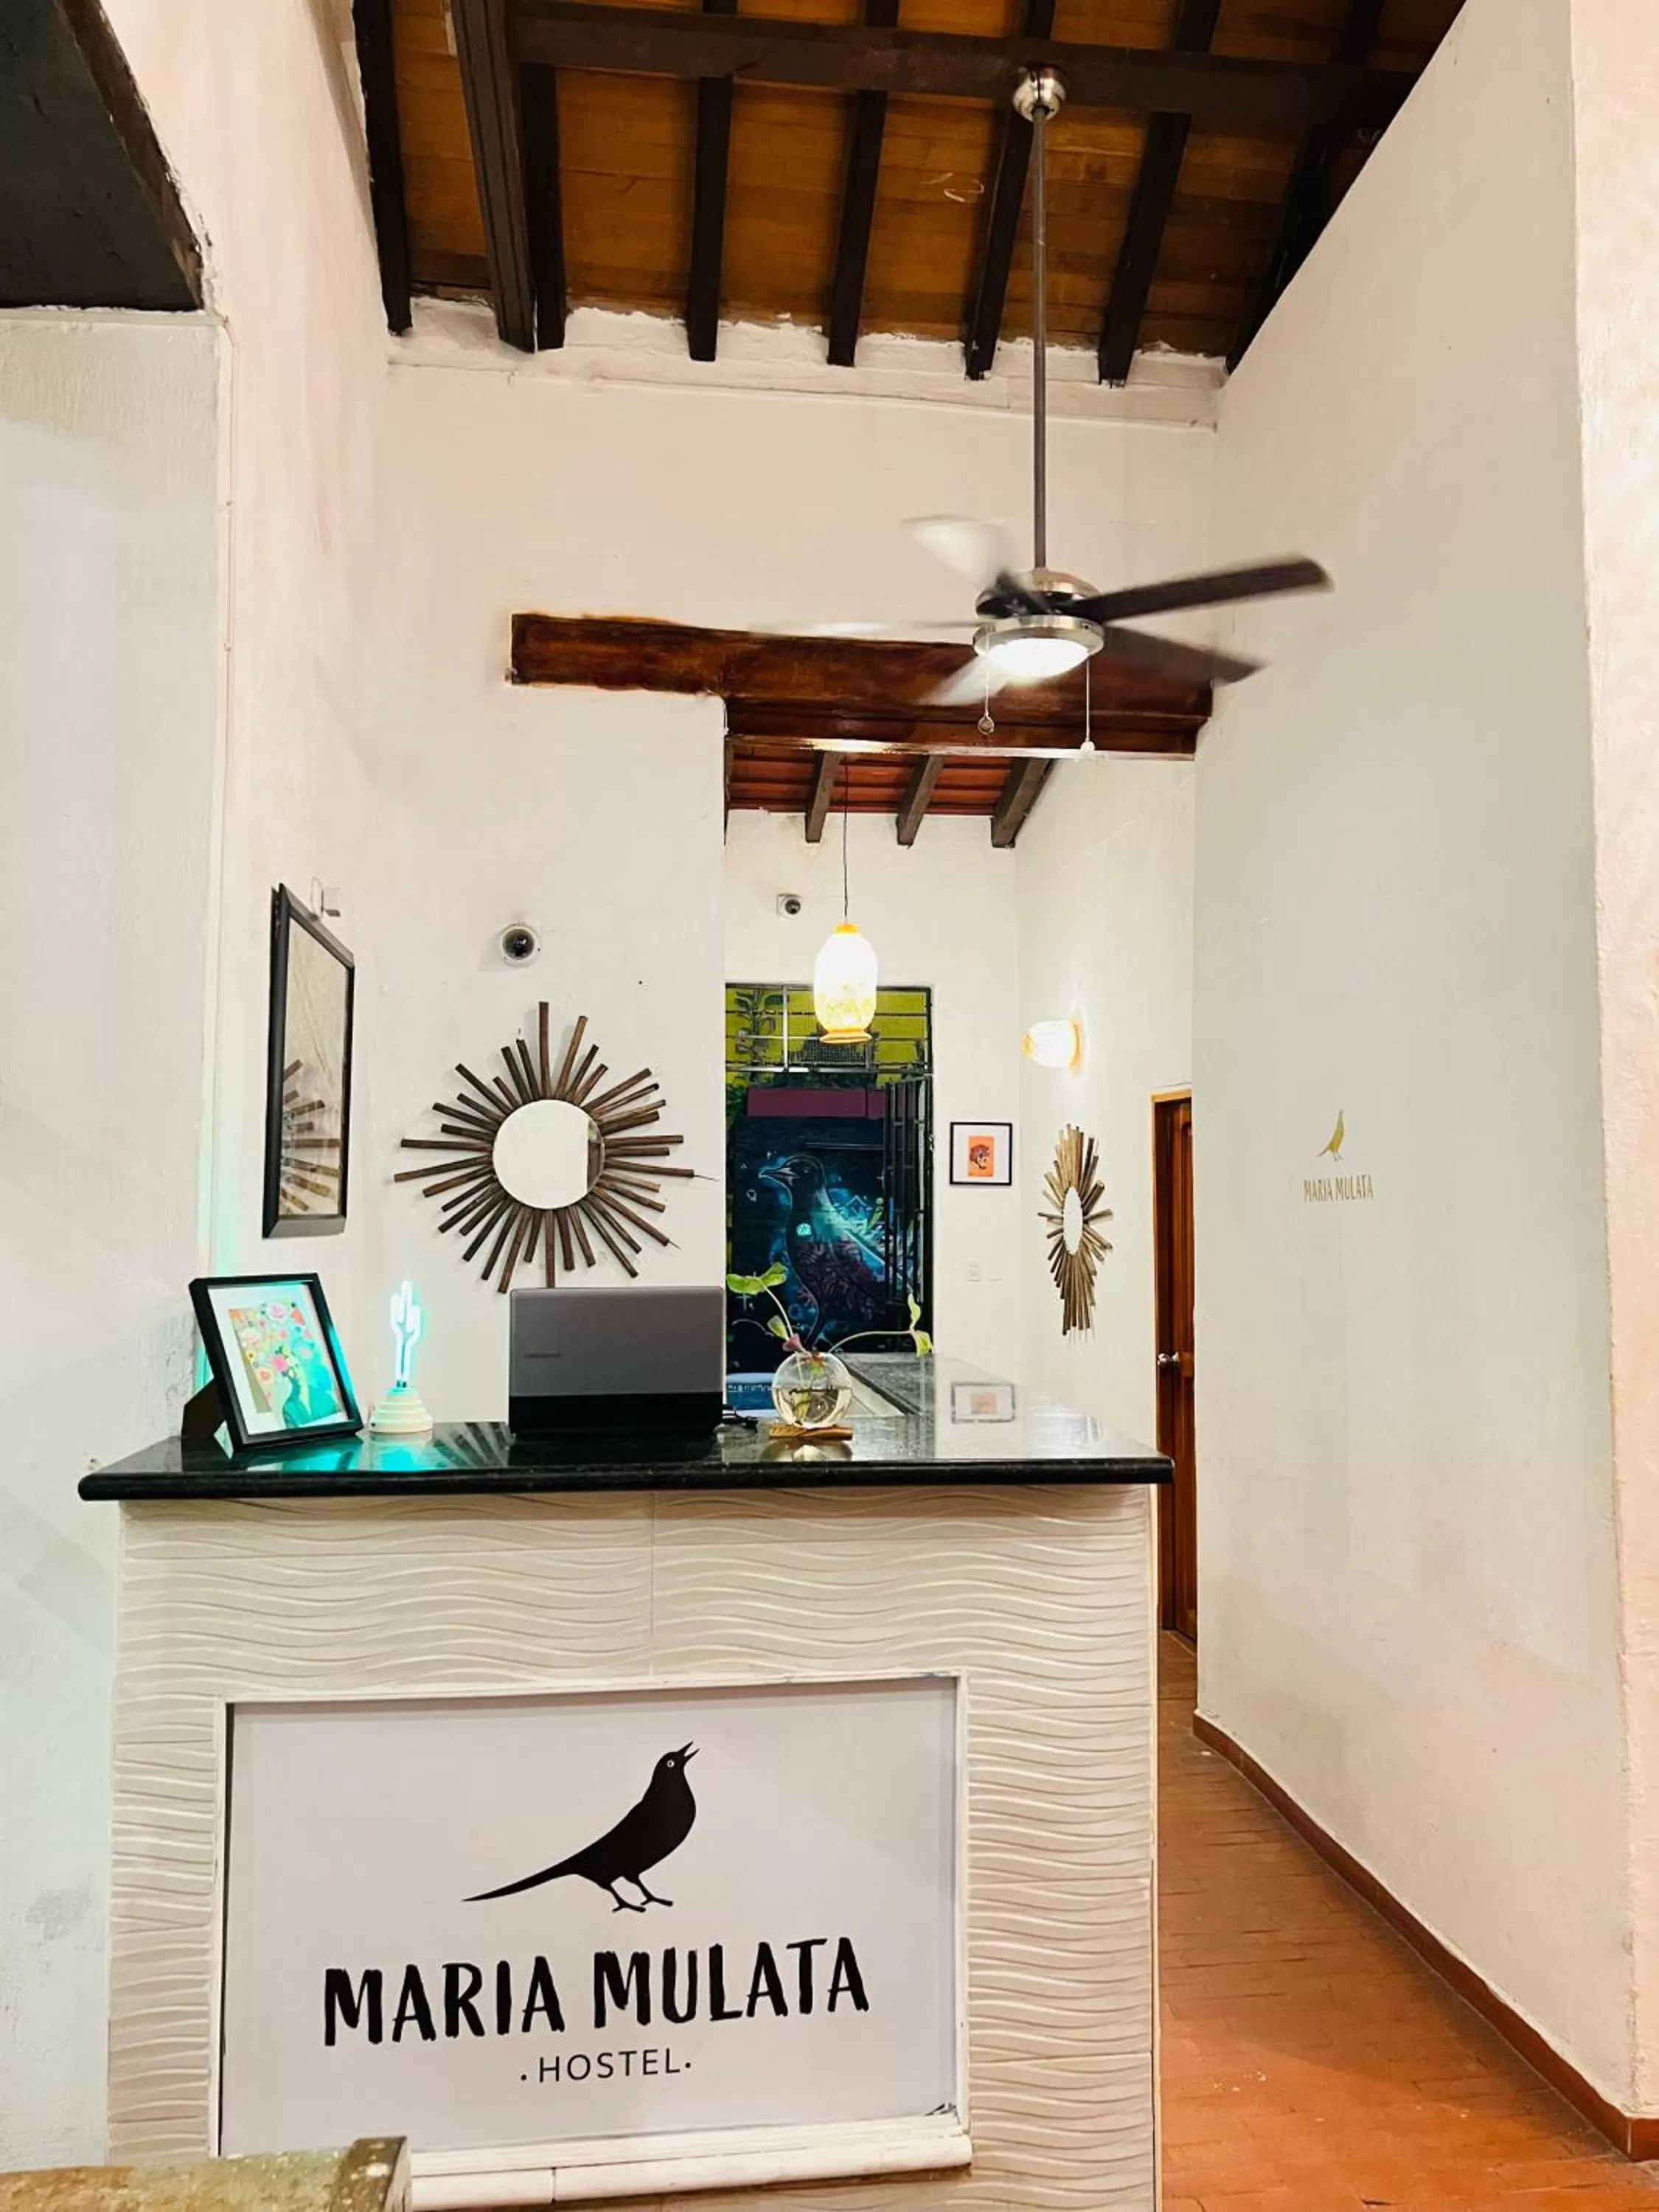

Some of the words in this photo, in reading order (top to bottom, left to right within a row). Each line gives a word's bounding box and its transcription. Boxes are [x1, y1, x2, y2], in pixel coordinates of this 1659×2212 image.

[1303, 1178, 1333, 1203] MARIA
[1335, 1173, 1374, 1201] MULATA
[324, 1955, 566, 2046] MARIA
[594, 1937, 869, 2029] MULATA
